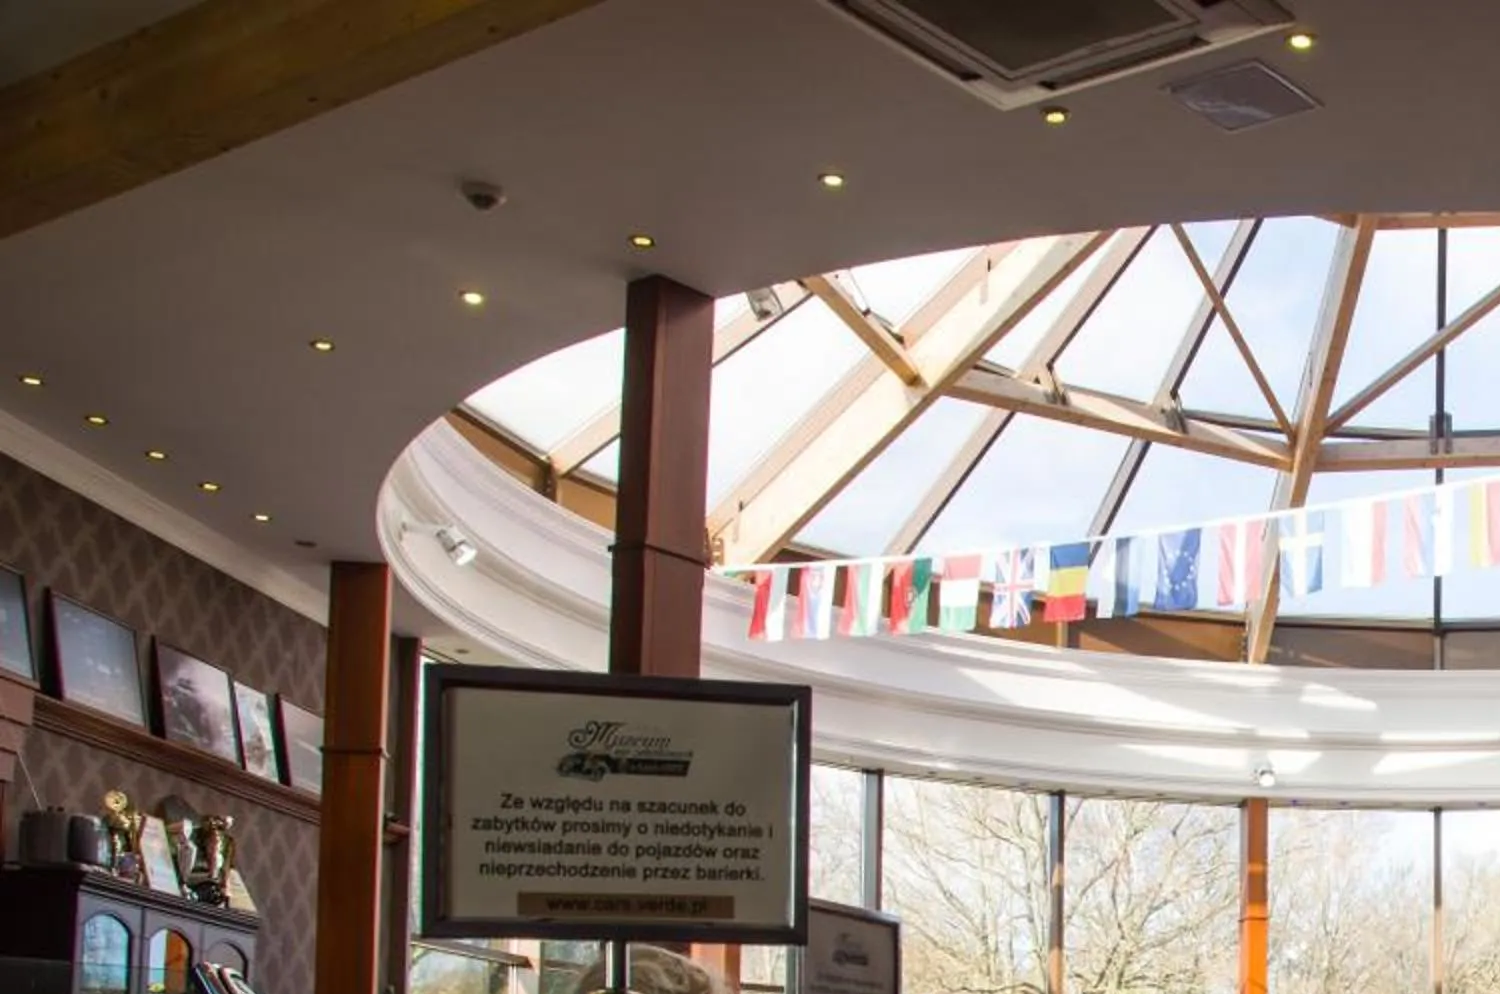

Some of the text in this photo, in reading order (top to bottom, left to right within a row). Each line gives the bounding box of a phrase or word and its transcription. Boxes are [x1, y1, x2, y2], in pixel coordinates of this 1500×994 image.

[500, 793, 747, 817] Ze względu na szacunek do
[471, 815, 557, 835] zabytków
[562, 819, 632, 839] prosimy
[637, 823, 648, 835] o
[654, 819, 763, 841] niedotykanie
[484, 837, 761, 861] niewsiadanie do pojazdów oraz
[479, 860, 766, 882] nieprzechodzenie przez barierki.
